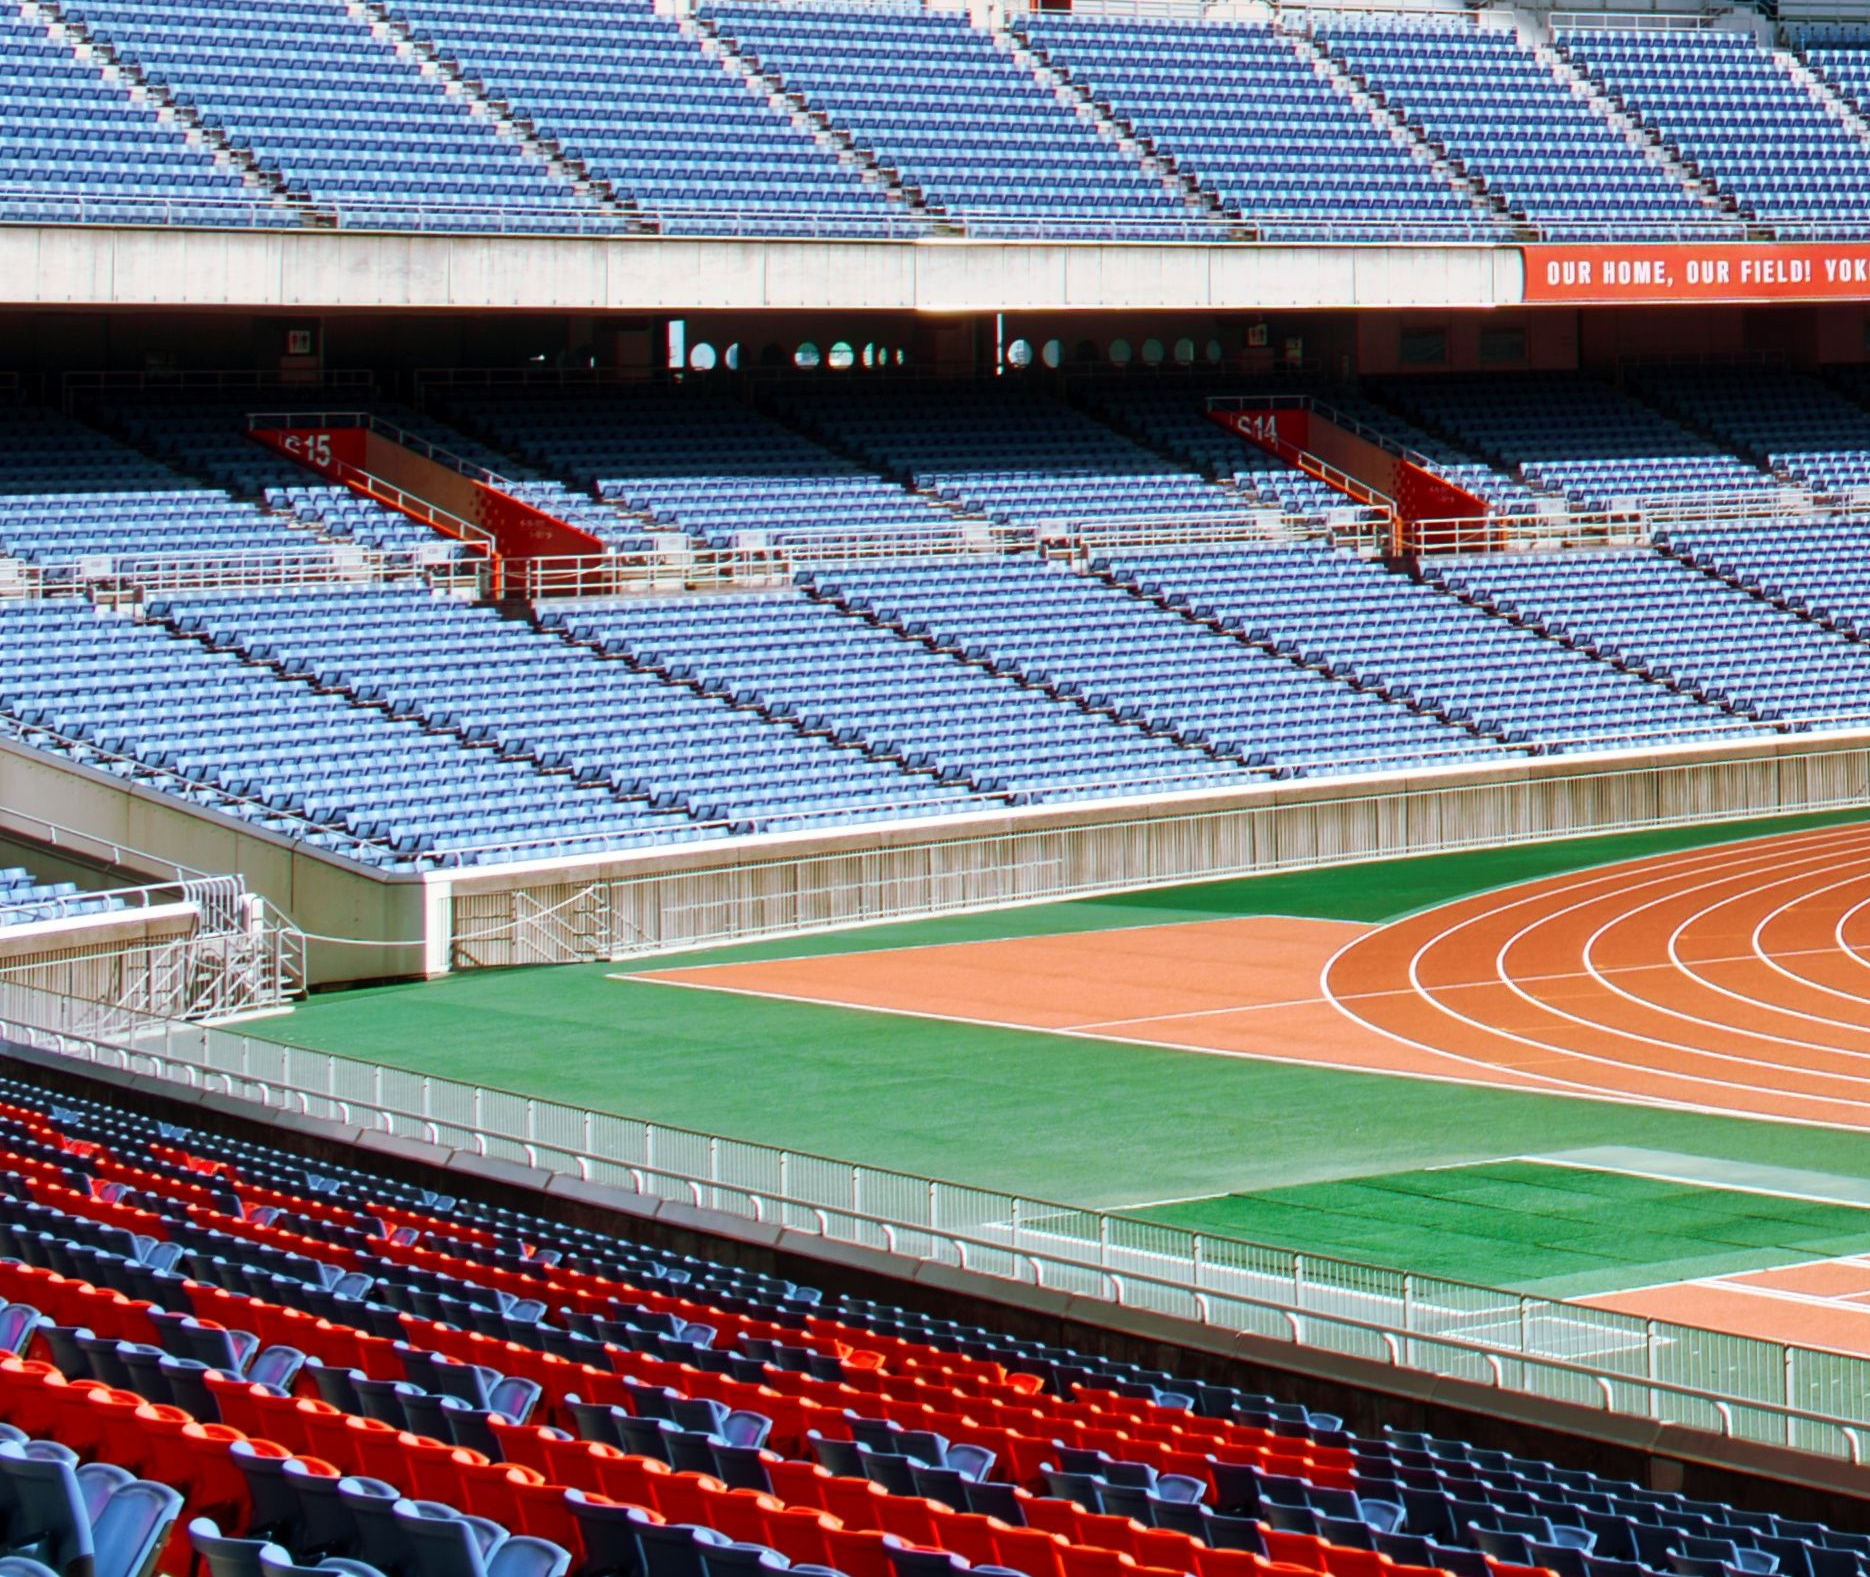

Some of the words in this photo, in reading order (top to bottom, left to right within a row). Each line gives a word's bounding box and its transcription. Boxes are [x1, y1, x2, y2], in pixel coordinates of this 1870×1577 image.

[1547, 260, 1591, 286] OUR
[1603, 260, 1673, 288] HOME,
[1686, 259, 1730, 285] OUR
[1740, 258, 1812, 284] FIELD!
